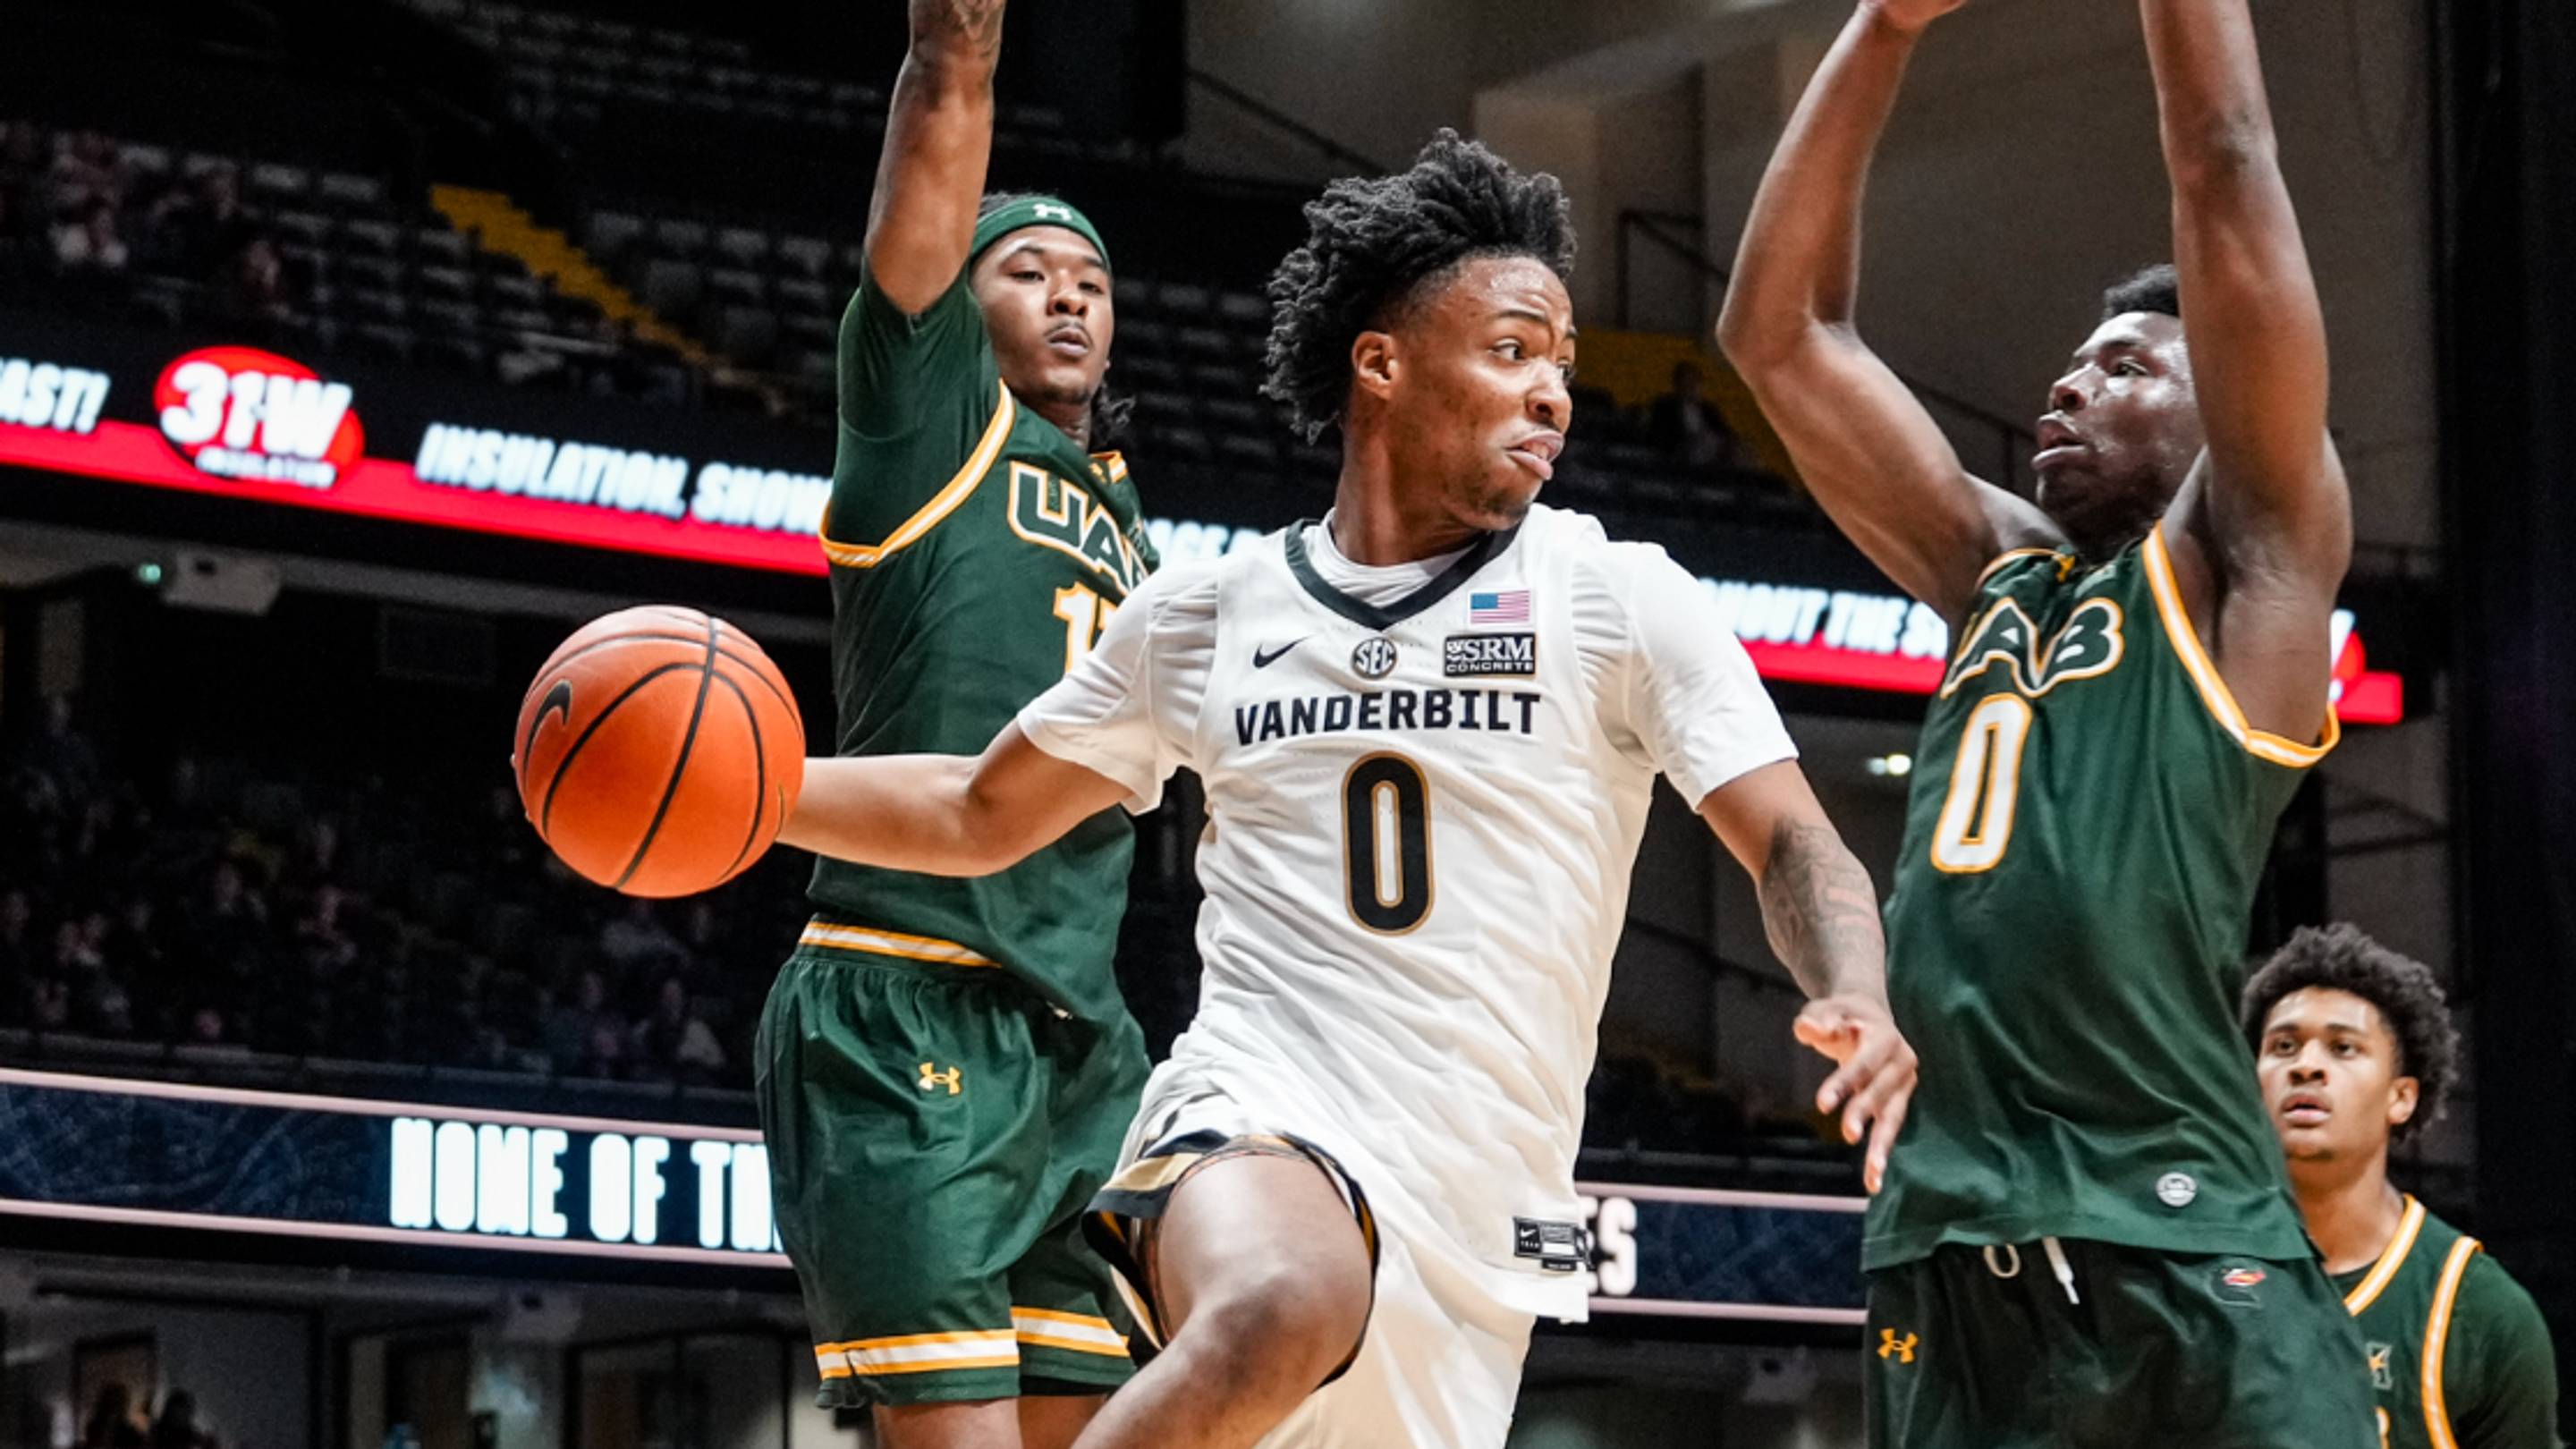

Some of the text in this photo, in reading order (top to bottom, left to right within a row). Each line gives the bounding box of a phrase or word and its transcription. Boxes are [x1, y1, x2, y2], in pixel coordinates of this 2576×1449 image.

[0, 360, 111, 435] AST!
[691, 462, 834, 536] SHOW
[1007, 461, 1150, 597] UA
[1053, 581, 1120, 674] 1
[1354, 637, 1395, 676] SEC
[1446, 661, 1534, 673] CONCRETE
[1462, 636, 1534, 662] SRM
[1940, 596, 2124, 699] AB
[1235, 689, 1541, 747] VANDERBILT
[1930, 692, 2032, 874] 0
[1343, 750, 1435, 937] 0
[391, 1117, 569, 1238] HOME
[589, 1133, 670, 1245] OF
[691, 1140, 784, 1253] TH
